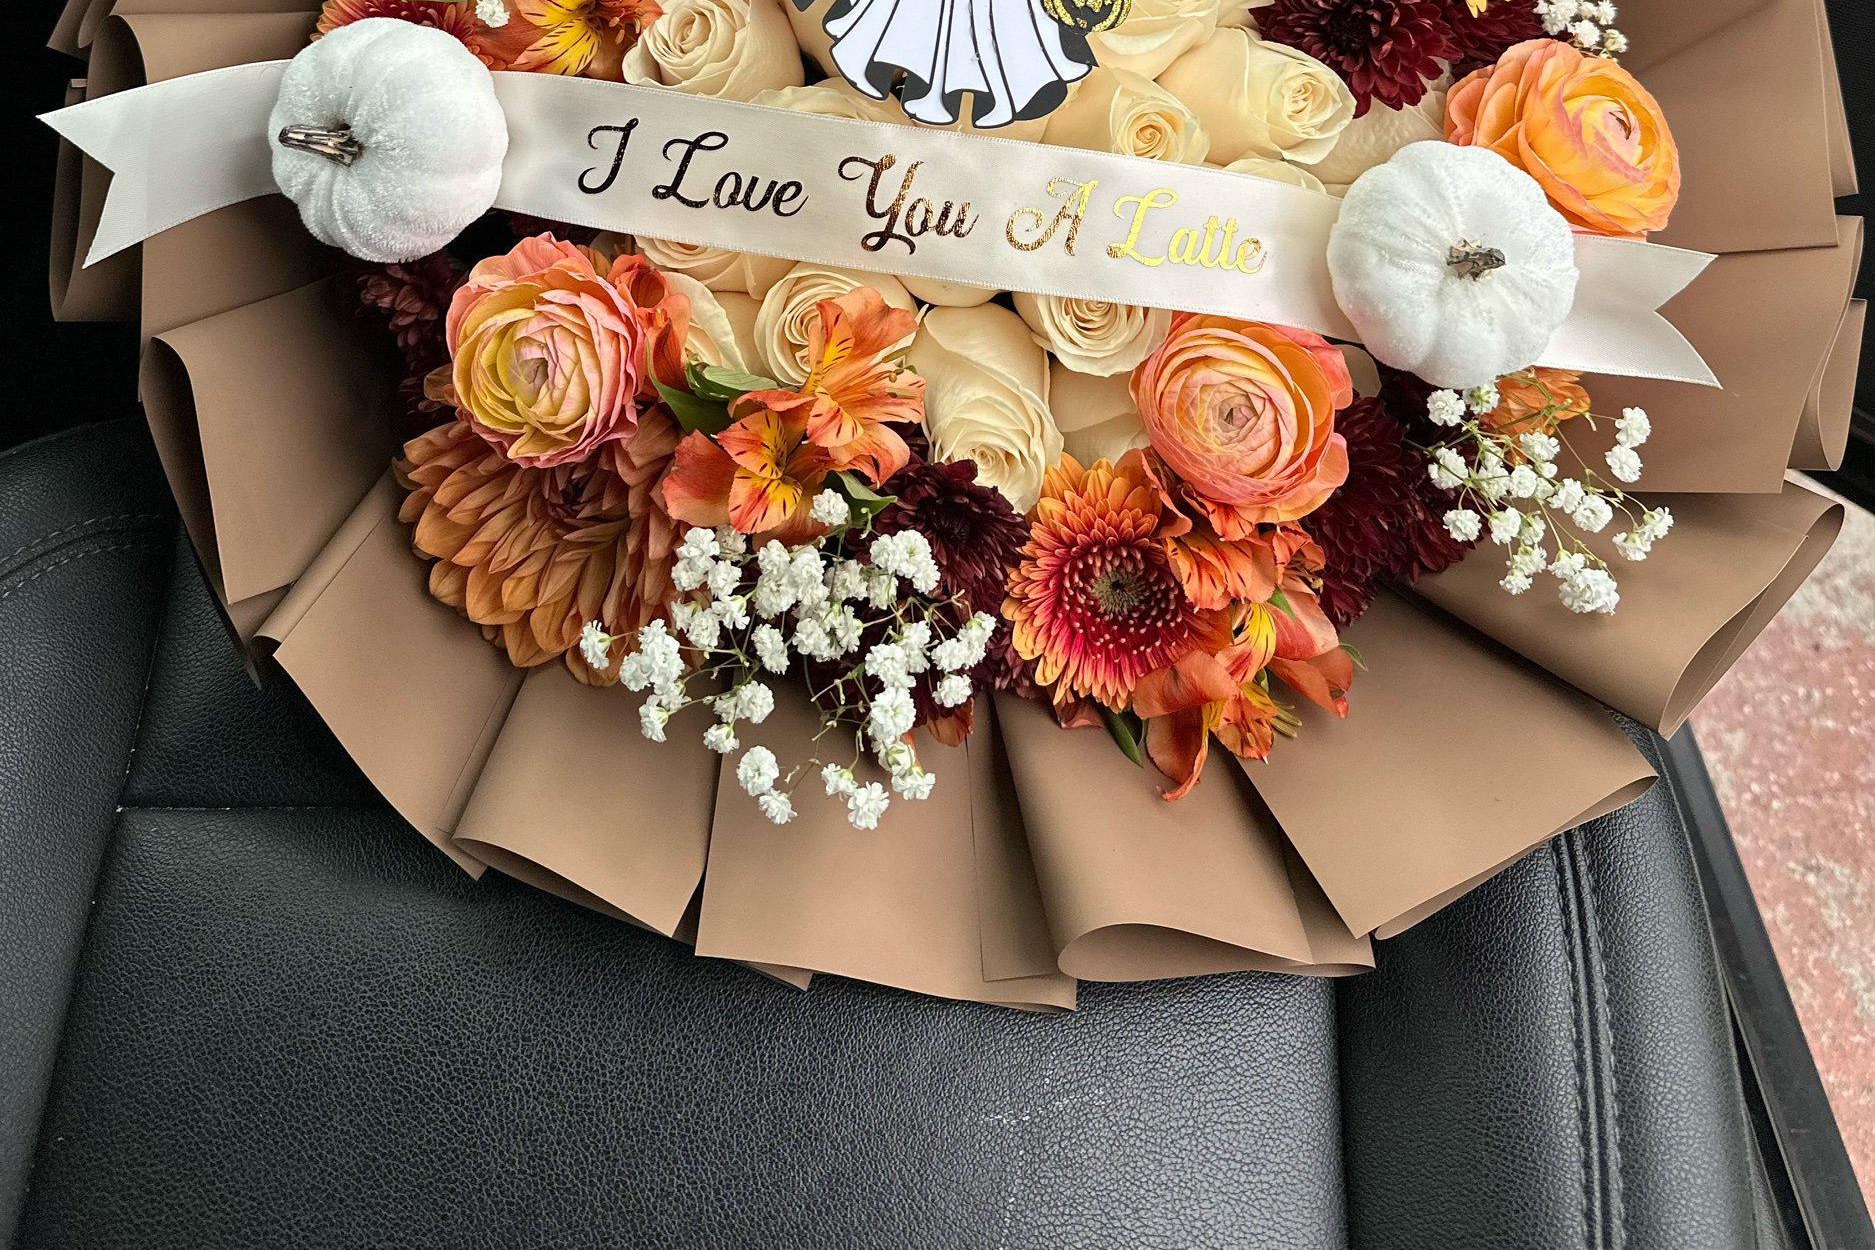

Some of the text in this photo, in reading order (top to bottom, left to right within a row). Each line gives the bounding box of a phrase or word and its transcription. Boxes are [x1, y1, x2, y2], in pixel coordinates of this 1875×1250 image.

[651, 131, 810, 218] Love
[837, 153, 980, 256] You
[1005, 176, 1099, 257] A
[1106, 187, 1269, 275] Latte
